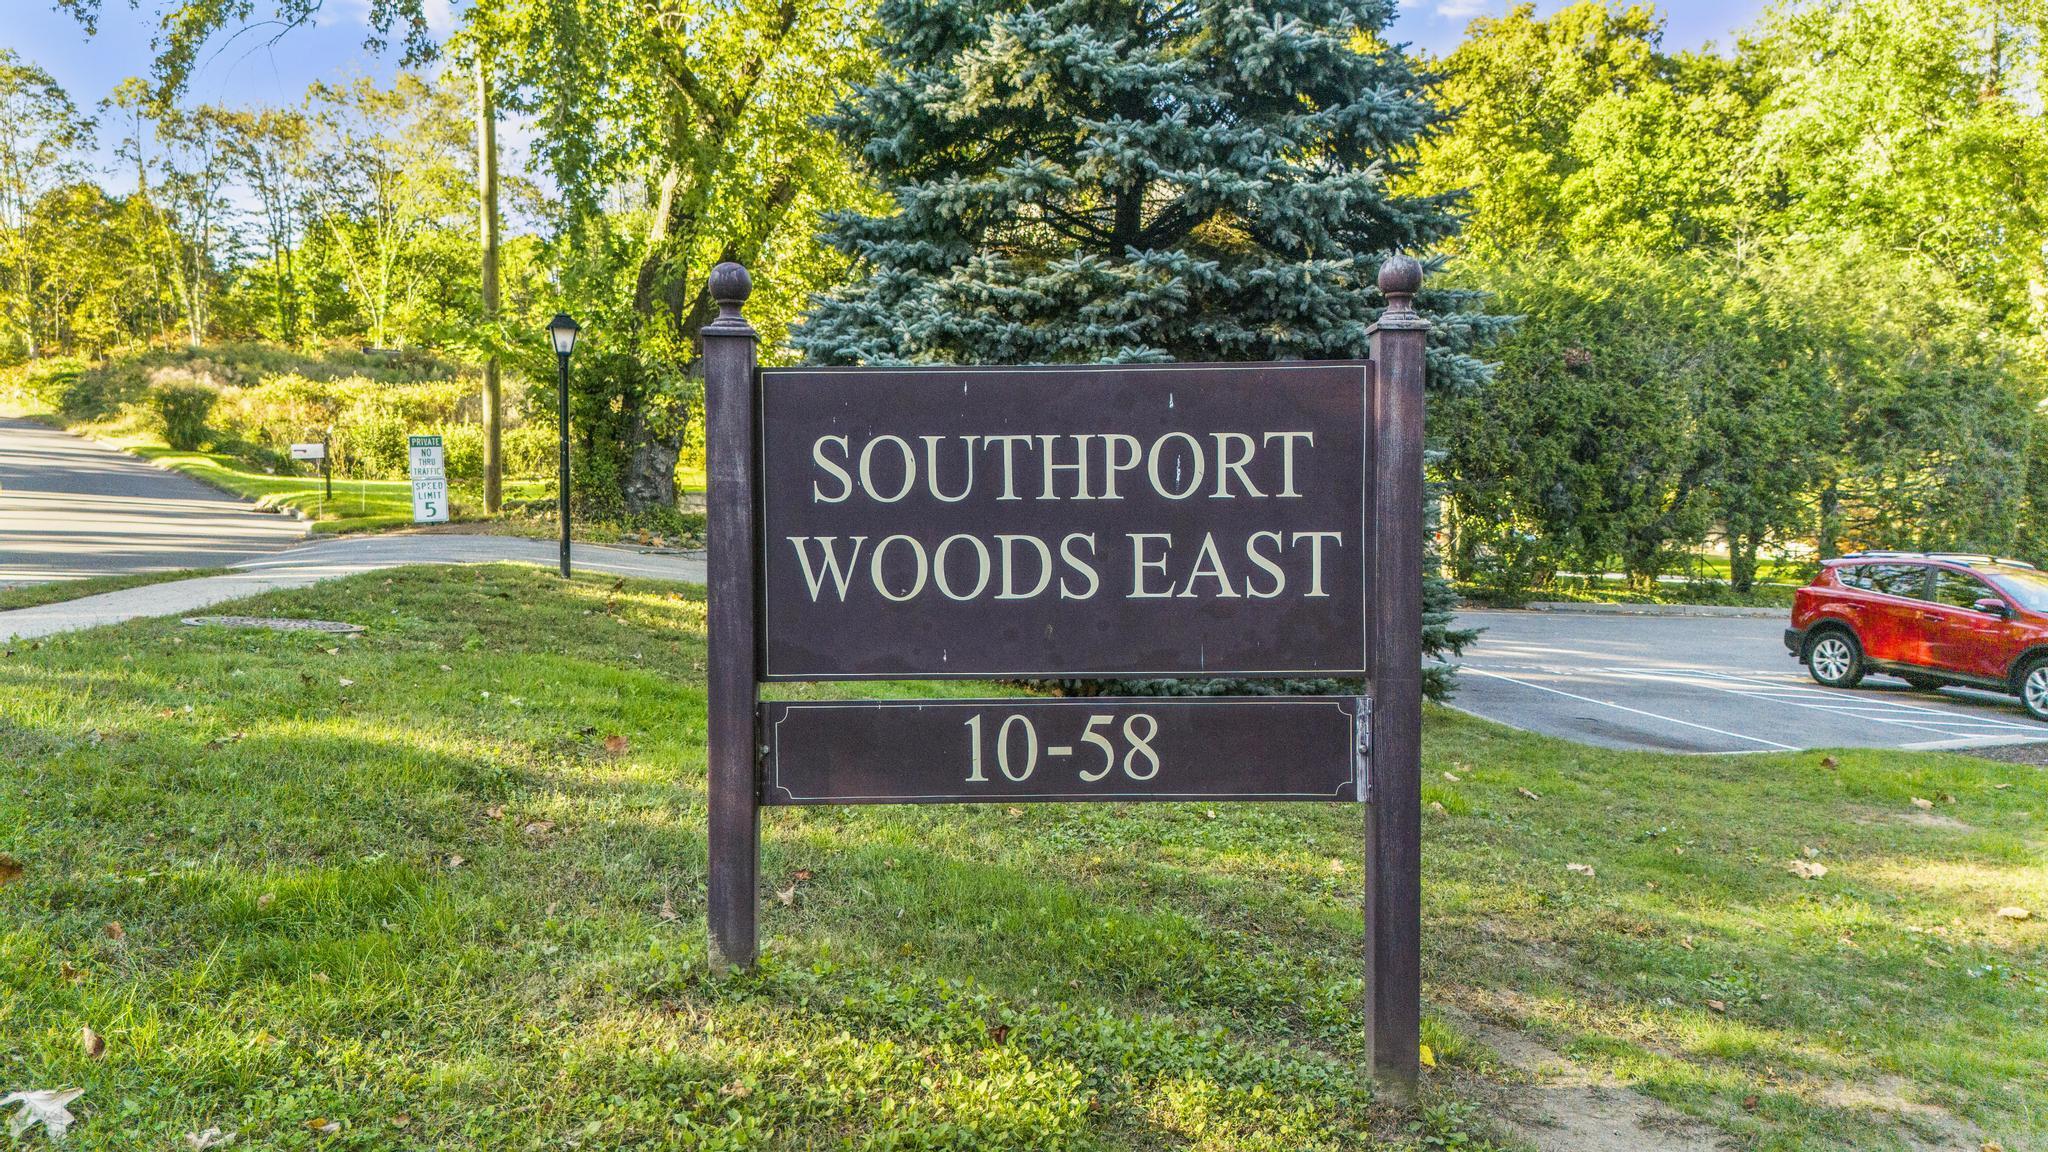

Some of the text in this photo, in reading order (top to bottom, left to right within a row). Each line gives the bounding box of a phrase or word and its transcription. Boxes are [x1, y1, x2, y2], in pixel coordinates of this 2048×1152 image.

[412, 438, 440, 446] PRIVATE
[421, 448, 432, 456] NO
[812, 431, 1314, 504] SOUTHPORT
[414, 468, 442, 476] TRAFFIC
[416, 482, 443, 490] SPEED
[418, 492, 442, 500] LIMIT
[425, 502, 436, 518] 5
[785, 530, 1343, 603] WOODS EAST
[964, 713, 1160, 782] 10-58
